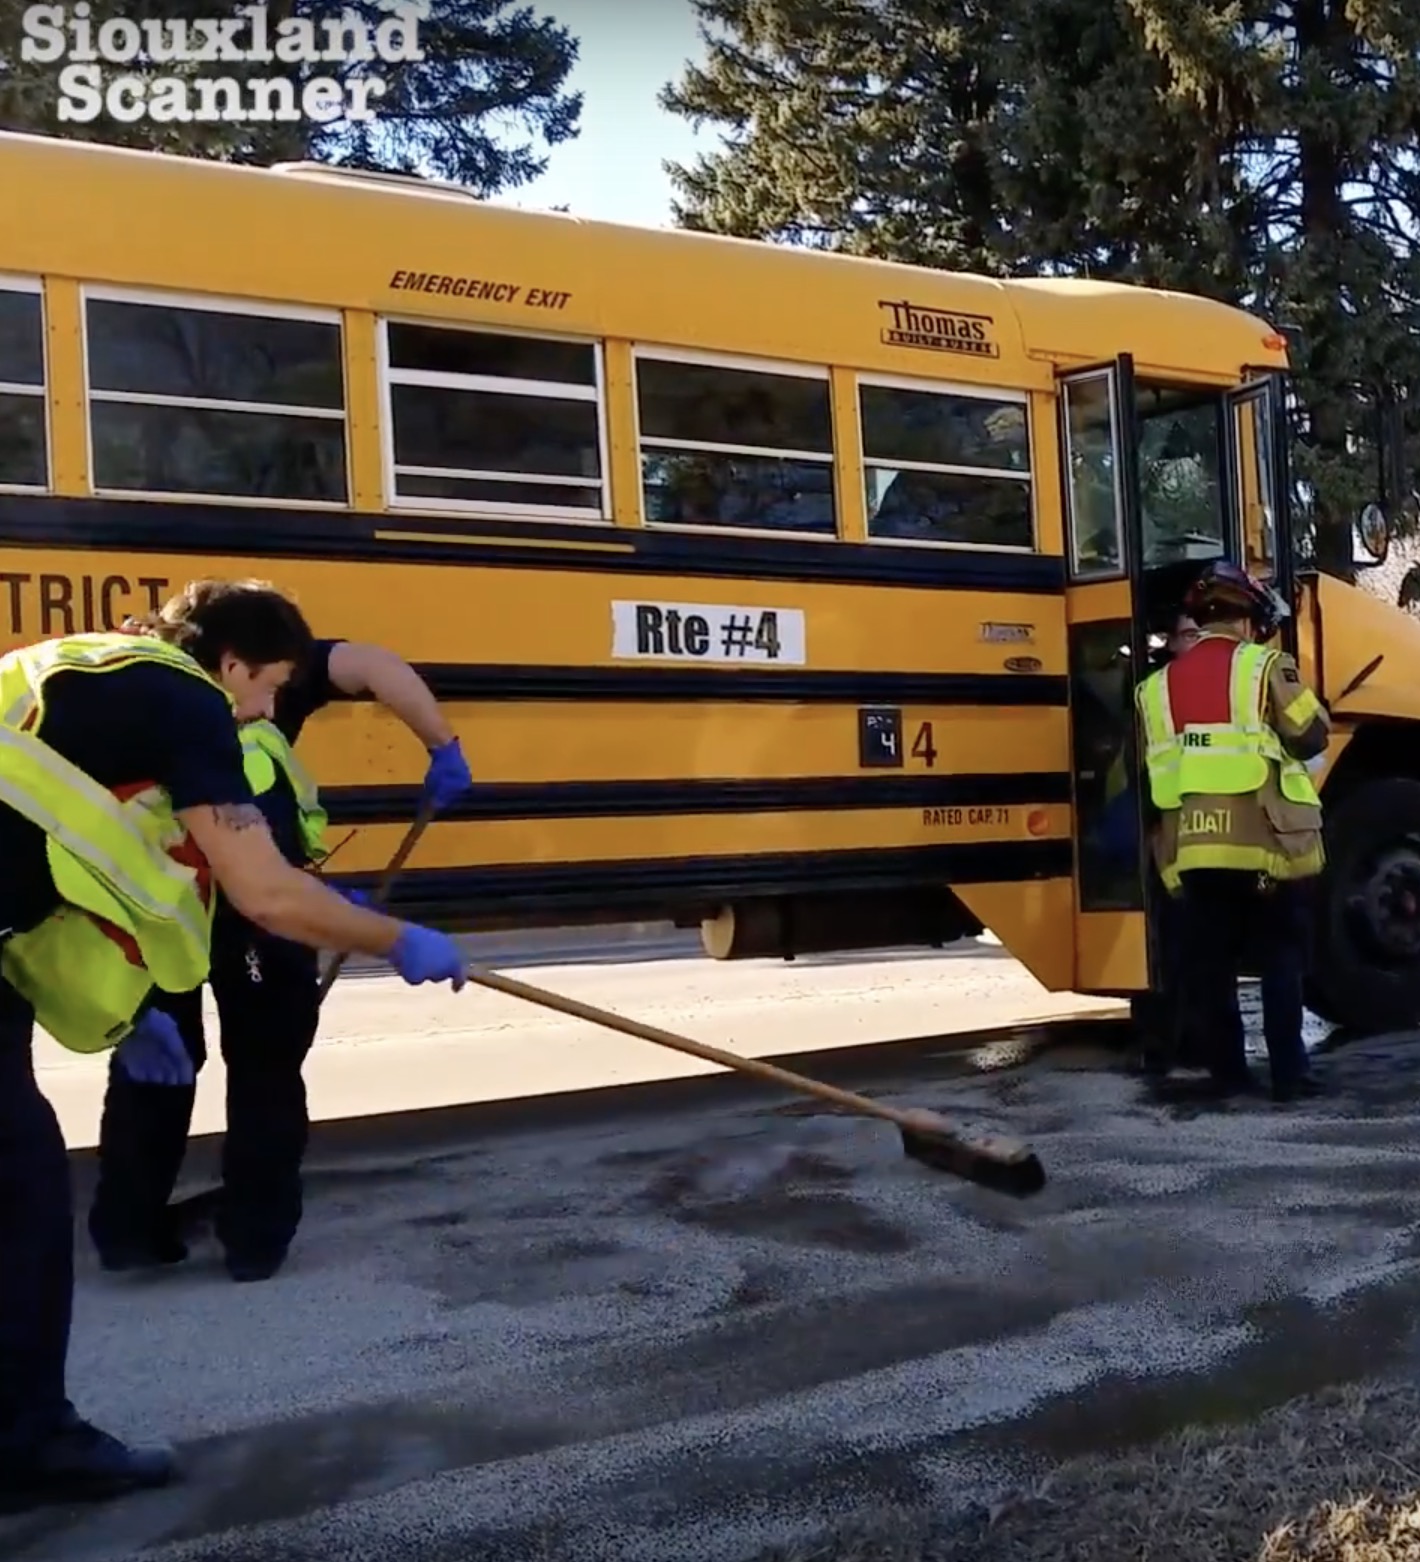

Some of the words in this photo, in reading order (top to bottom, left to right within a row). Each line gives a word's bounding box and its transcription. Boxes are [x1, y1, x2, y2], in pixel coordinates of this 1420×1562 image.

[389, 270, 520, 303] EMERGENCY
[524, 288, 572, 310] EXIT
[878, 300, 993, 340] Thomas
[636, 604, 709, 656] Rte
[720, 611, 781, 658] #4
[881, 732, 895, 756] 4
[911, 721, 938, 768] 4
[923, 808, 962, 826] RATED
[997, 807, 1009, 825] 71
